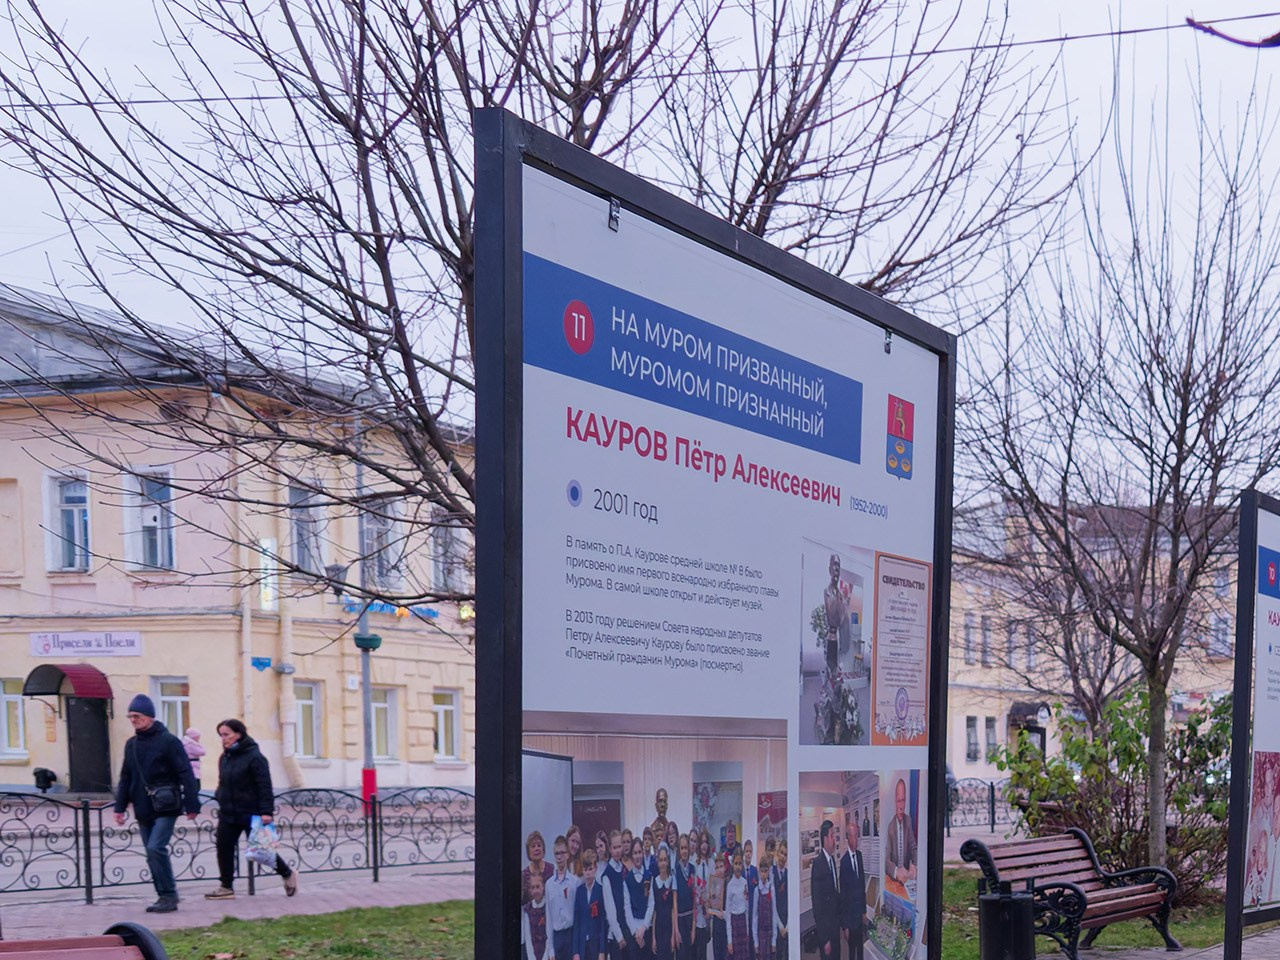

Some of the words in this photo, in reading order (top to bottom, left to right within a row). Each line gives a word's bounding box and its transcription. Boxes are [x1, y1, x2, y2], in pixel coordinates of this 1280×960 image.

[572, 312, 586, 341] 11
[612, 306, 639, 340] НА
[645, 318, 712, 365] МУРОМ
[717, 344, 828, 410] ПРИЗВАННЫЙ,
[611, 346, 710, 401] МУРОМОМ
[715, 381, 824, 438] ПРИЗНАННЫЙ
[566, 406, 668, 462] КАУРОВ
[675, 436, 727, 483] Пётр
[732, 453, 841, 507] Алексеевич
[850, 496, 889, 520] (1952-2000)
[594, 488, 628, 515] 2001
[633, 501, 659, 525] год
[566, 534, 573, 548] В
[575, 539, 607, 554] память
[609, 545, 615, 555] о
[616, 543, 633, 557] П.А.
[634, 547, 669, 564] Каурове
[670, 555, 703, 569] средней
[704, 562, 729, 574] школе
[744, 565, 763, 580] было
[566, 556, 616, 573] присвоено
[617, 565, 635, 576] имя
[636, 567, 670, 581] первого
[671, 573, 716, 589] всенародно
[718, 579, 759, 594] избранного
[760, 587, 779, 598] главы
[566, 573, 604, 589] Мурома.
[606, 578, 613, 591] В
[614, 582, 641, 594] самой
[643, 586, 669, 599] школе
[670, 589, 697, 602] открыт
[698, 594, 704, 602] и
[704, 594, 741, 609] действует
[882, 574, 926, 591] СВИДЕТЕЛЬСТВО
[565, 609, 572, 622] В
[574, 610, 593, 624] 2013
[595, 614, 615, 629] году
[616, 617, 661, 631] решением
[663, 620, 689, 634] Совета
[690, 625, 726, 638] народных
[727, 630, 762, 642] депутатов
[565, 627, 593, 645] Петру
[595, 631, 650, 650] Алексеевичу
[652, 636, 684, 653] Каурову
[685, 639, 705, 652] было
[706, 643, 746, 656] присвоено
[746, 648, 770, 658] звание
[616, 652, 663, 666] гражданин
